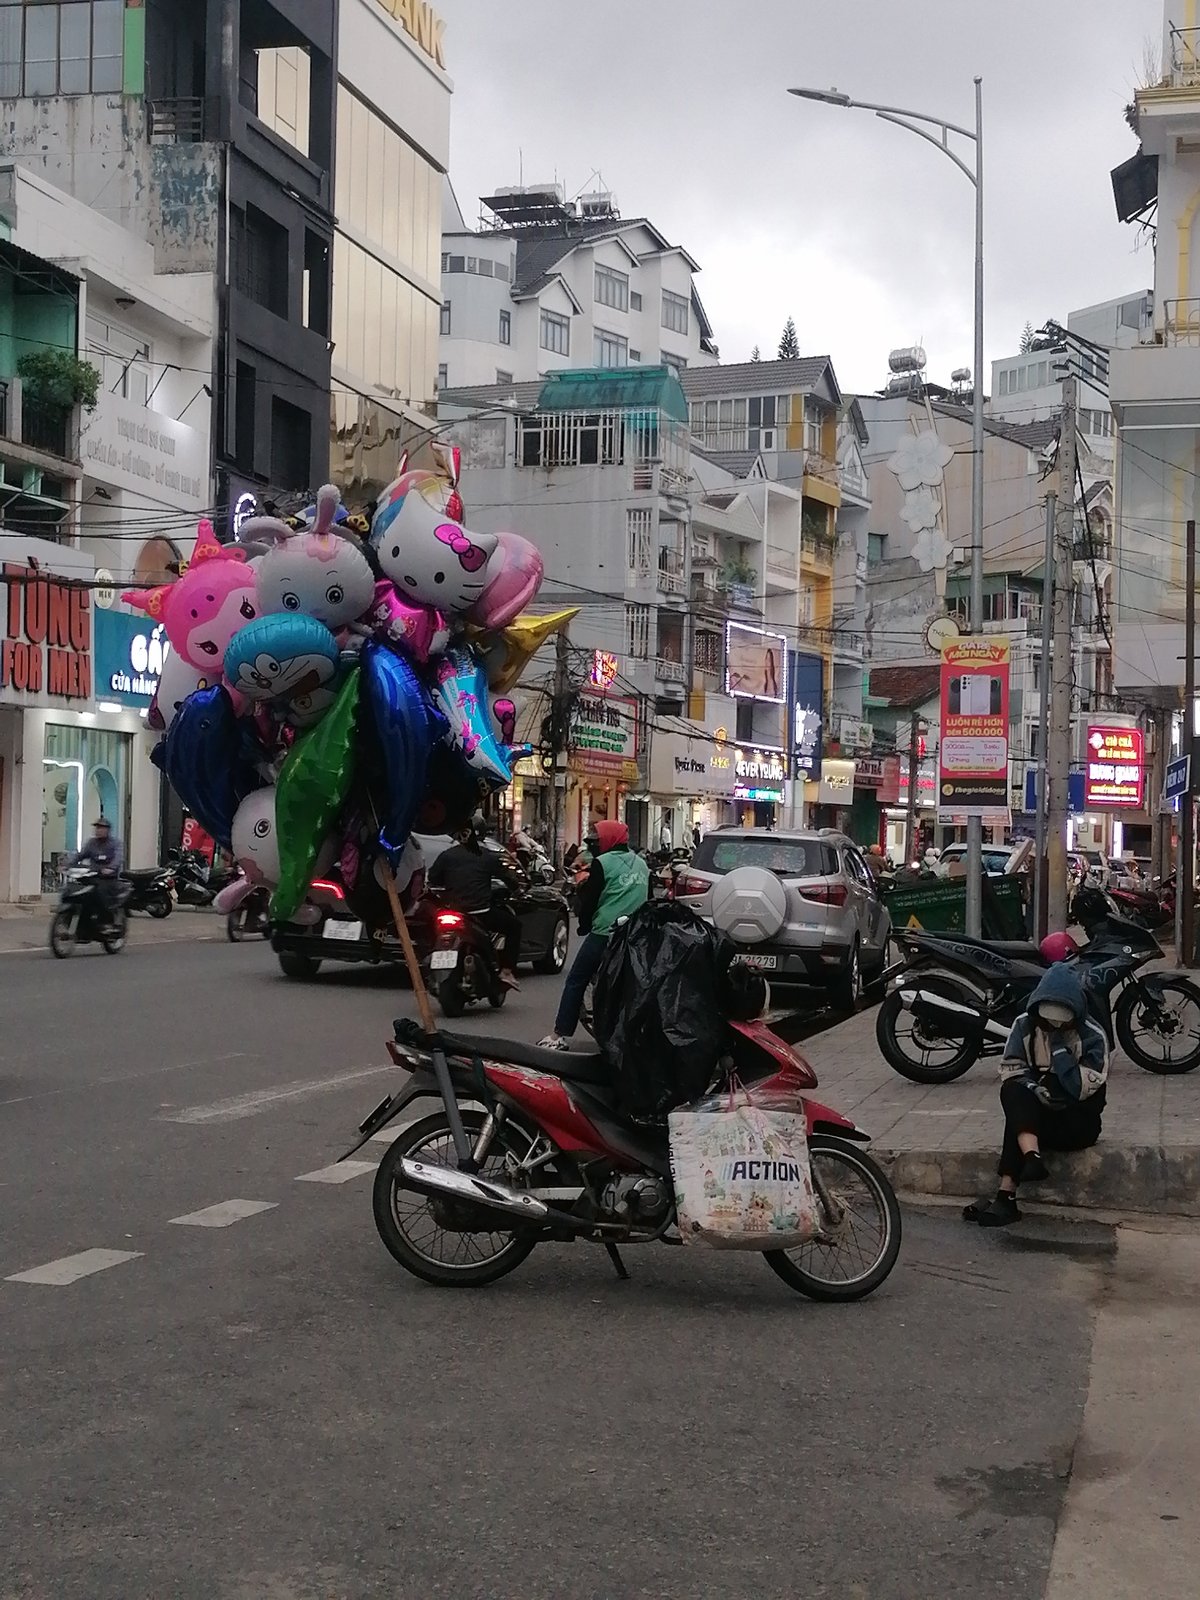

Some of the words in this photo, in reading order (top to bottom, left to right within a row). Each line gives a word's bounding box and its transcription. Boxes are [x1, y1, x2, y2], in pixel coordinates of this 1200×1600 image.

[3, 555, 90, 651] TÙNG
[1, 640, 42, 692] FOR
[48, 648, 91, 698] MEN
[962, 727, 1004, 736] 500.000
[735, 760, 759, 779] 4EVER
[759, 763, 783, 781] YOUNG
[732, 1160, 801, 1182] ACTION
